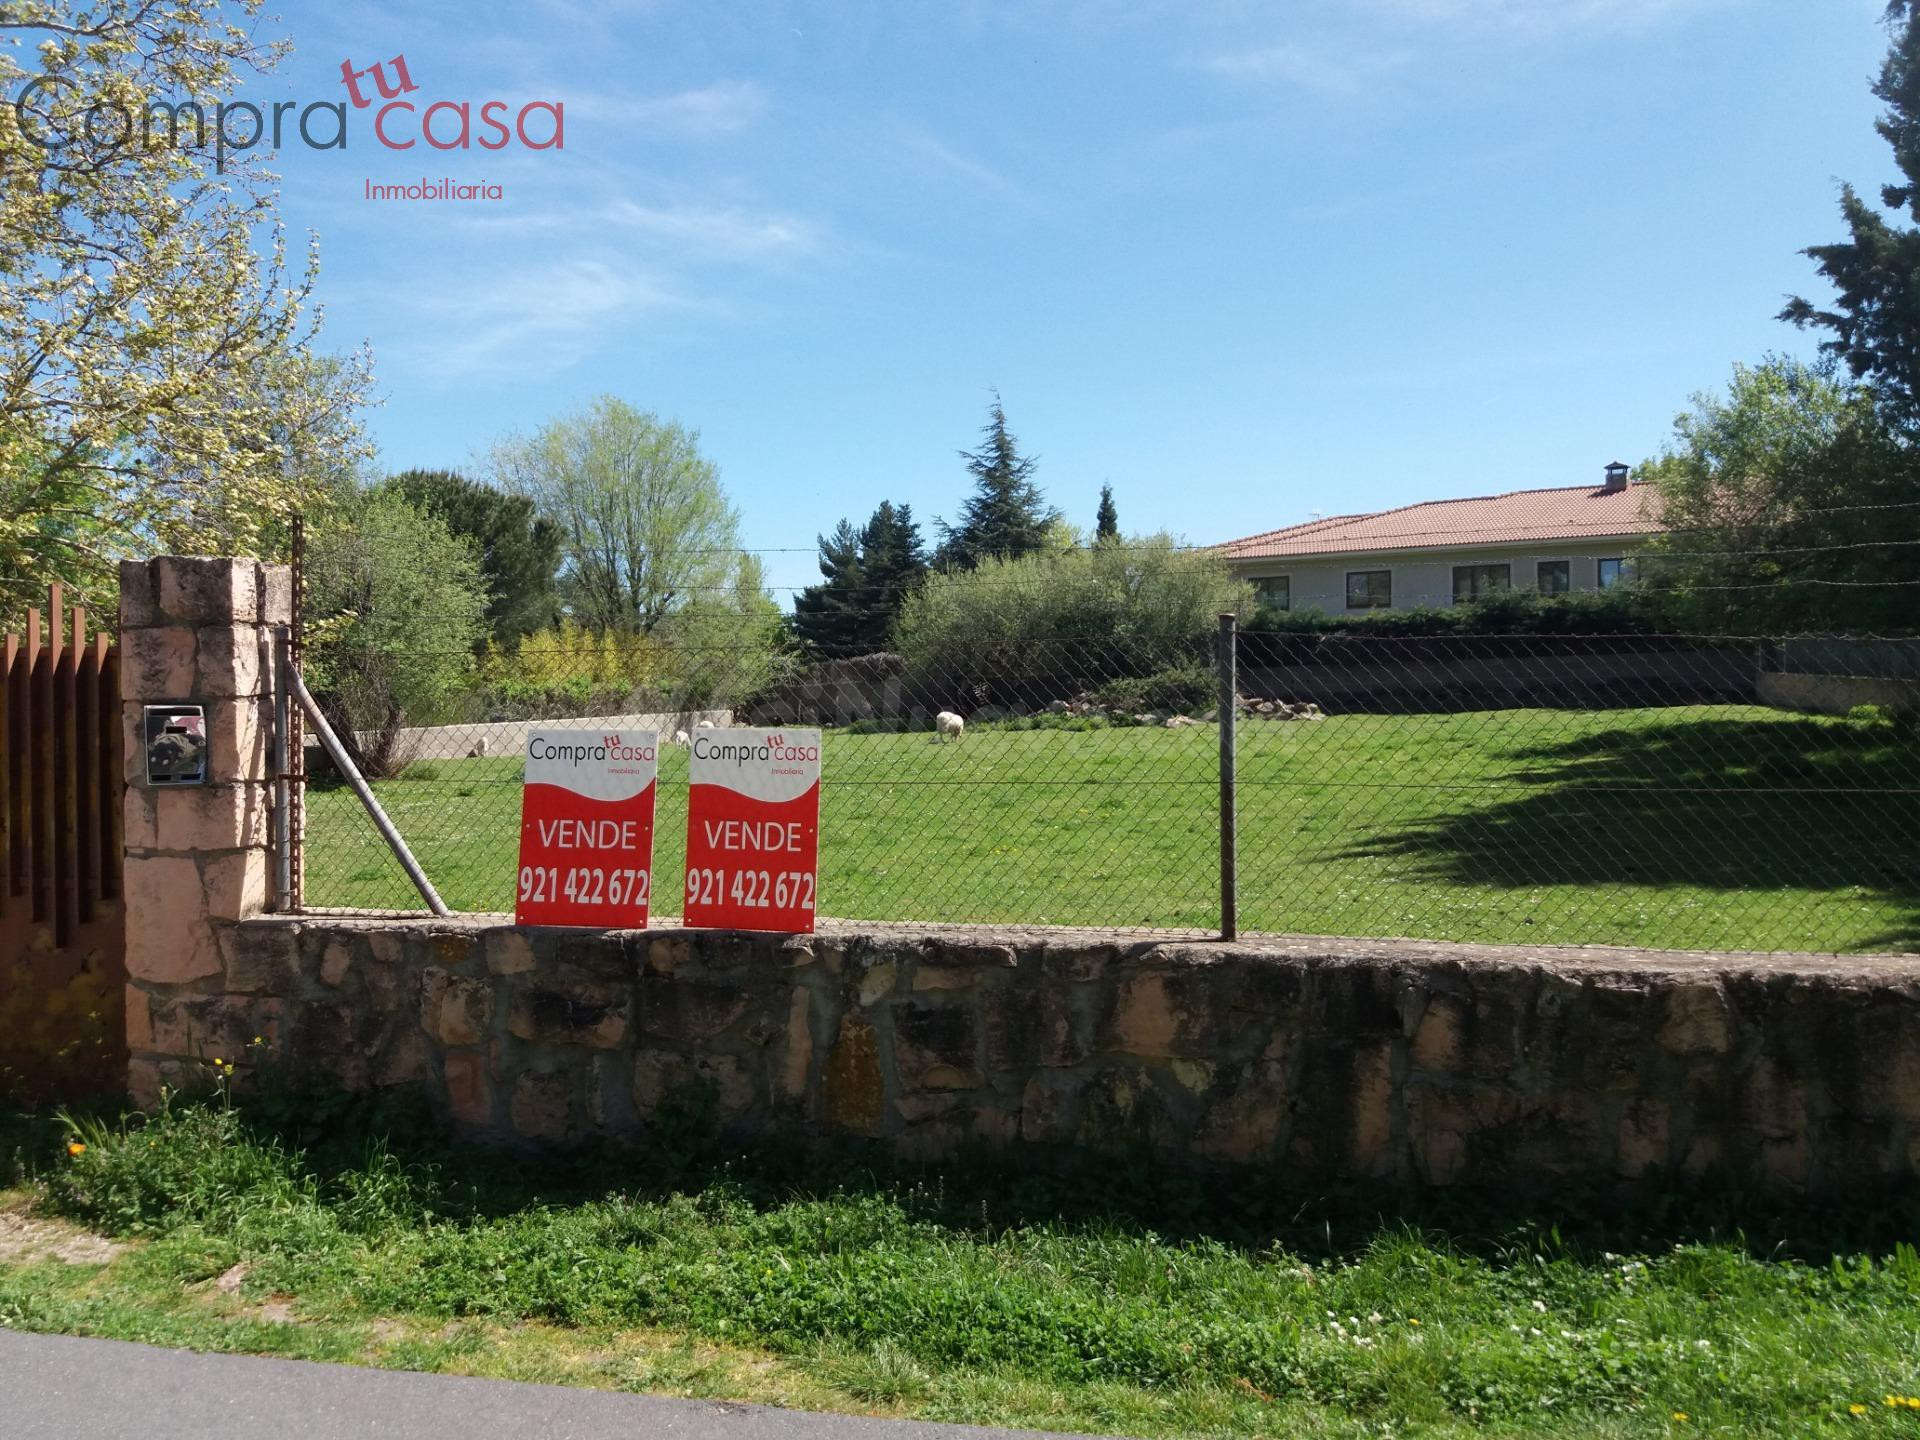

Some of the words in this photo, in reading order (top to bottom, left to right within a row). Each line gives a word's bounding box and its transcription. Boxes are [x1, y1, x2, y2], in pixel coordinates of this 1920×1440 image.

[529, 737, 606, 767] Compra
[603, 733, 621, 749] tu
[610, 745, 655, 761] casa
[694, 737, 770, 767] Compra
[766, 733, 784, 749] tu
[774, 745, 819, 762] casa
[538, 818, 638, 850] VENDE
[704, 820, 802, 852] VENDE
[519, 866, 558, 903] 921
[563, 867, 604, 905] 422
[608, 868, 649, 906] 672
[687, 867, 725, 905] 921
[731, 868, 770, 908] 422
[775, 870, 814, 910] 672
